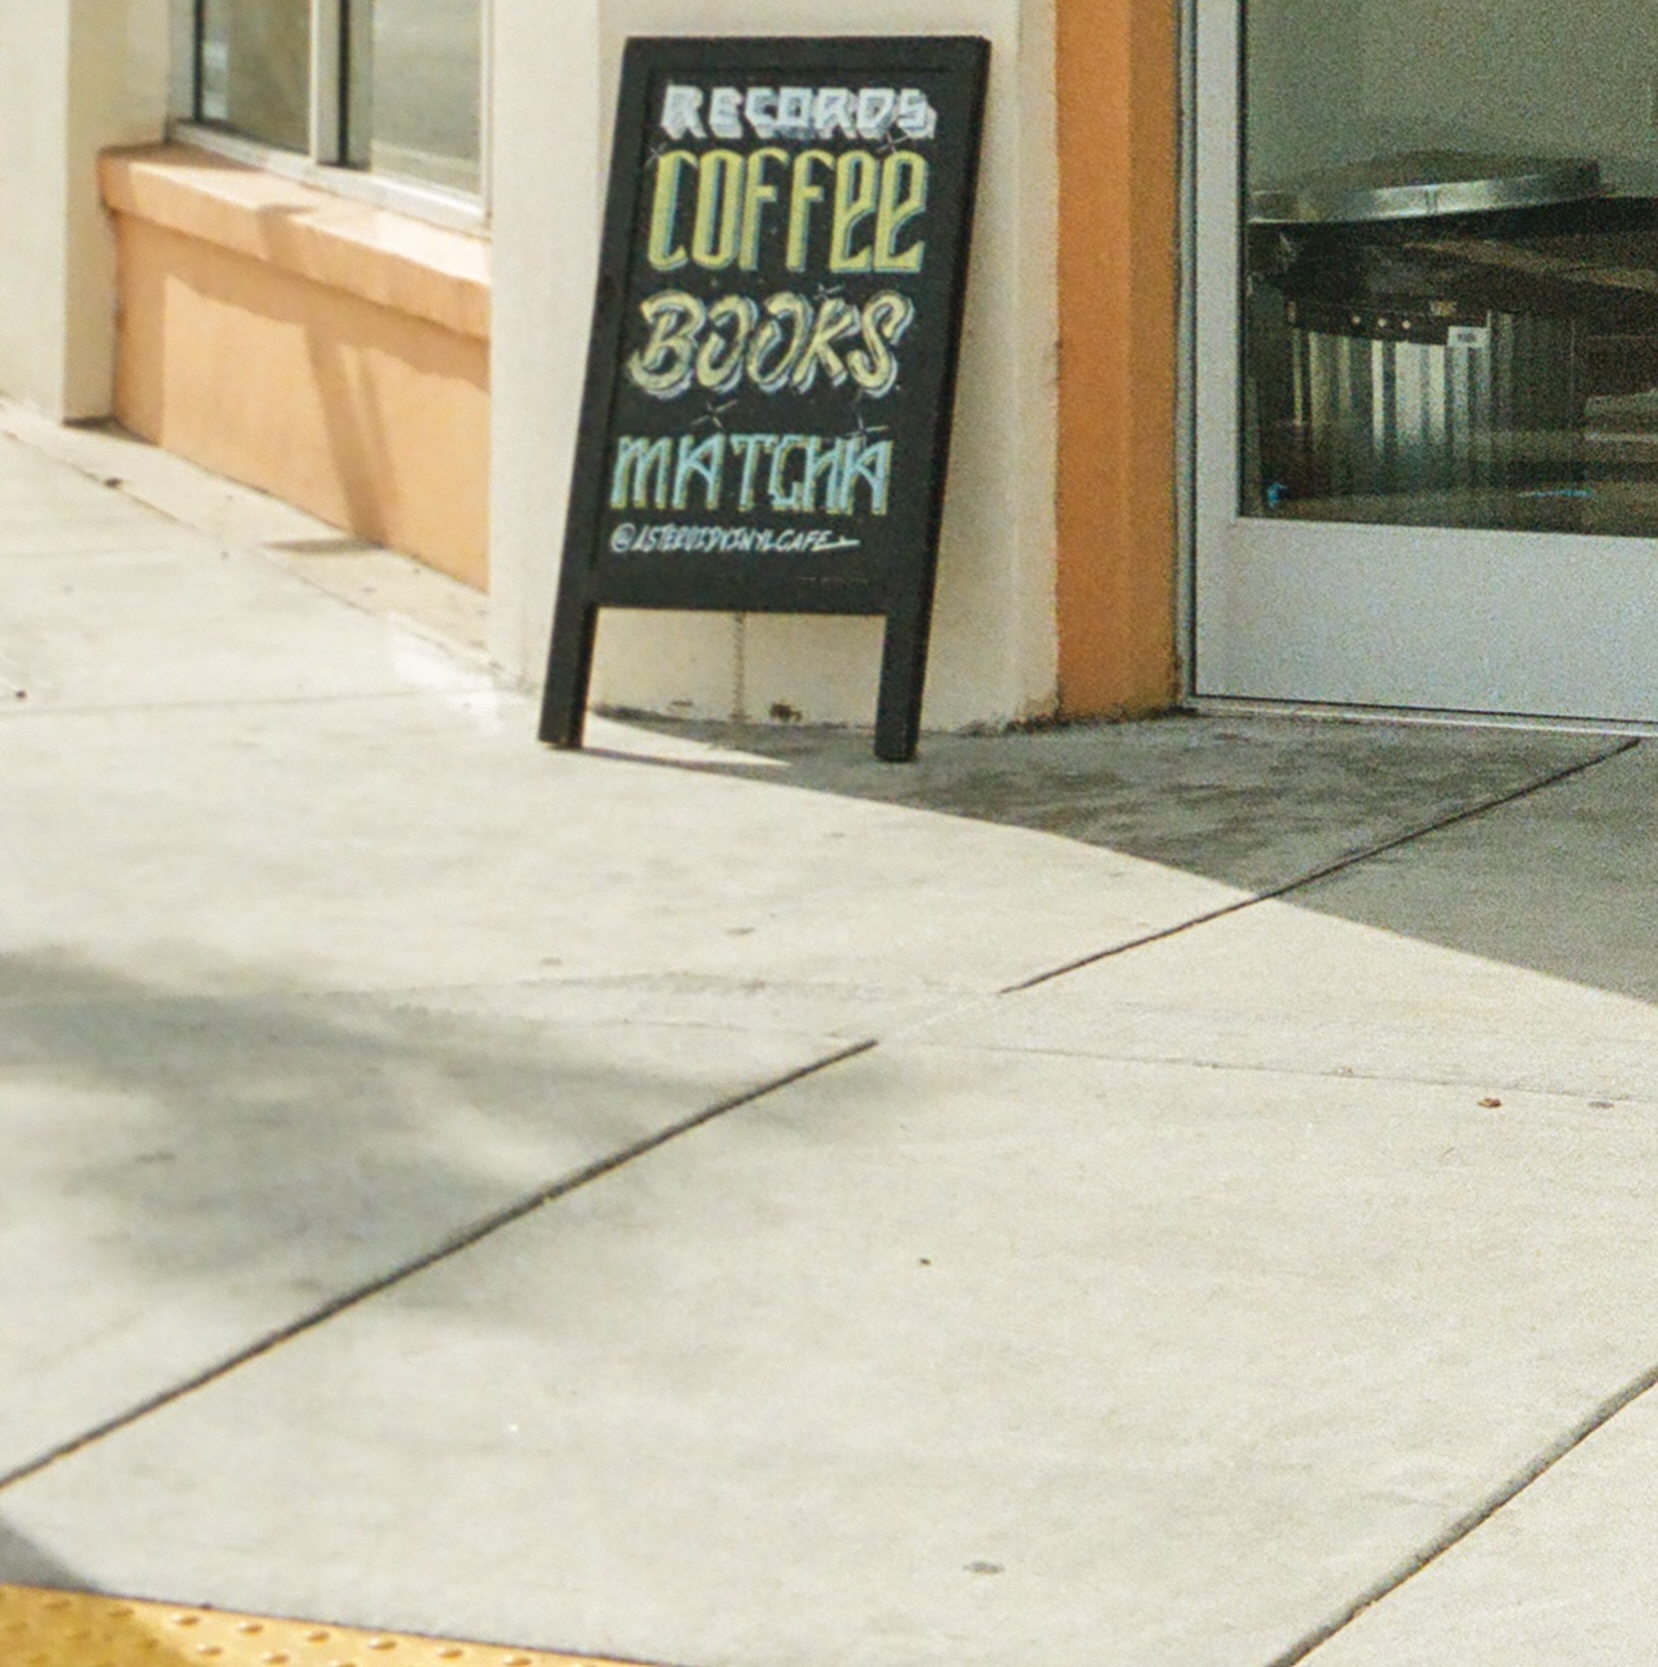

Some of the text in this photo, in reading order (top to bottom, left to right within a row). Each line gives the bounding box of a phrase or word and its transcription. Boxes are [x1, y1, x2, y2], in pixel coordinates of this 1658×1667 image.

[660, 83, 938, 141] RECORDS
[630, 289, 916, 399] BOOKS
[610, 433, 894, 516] MATCHA
